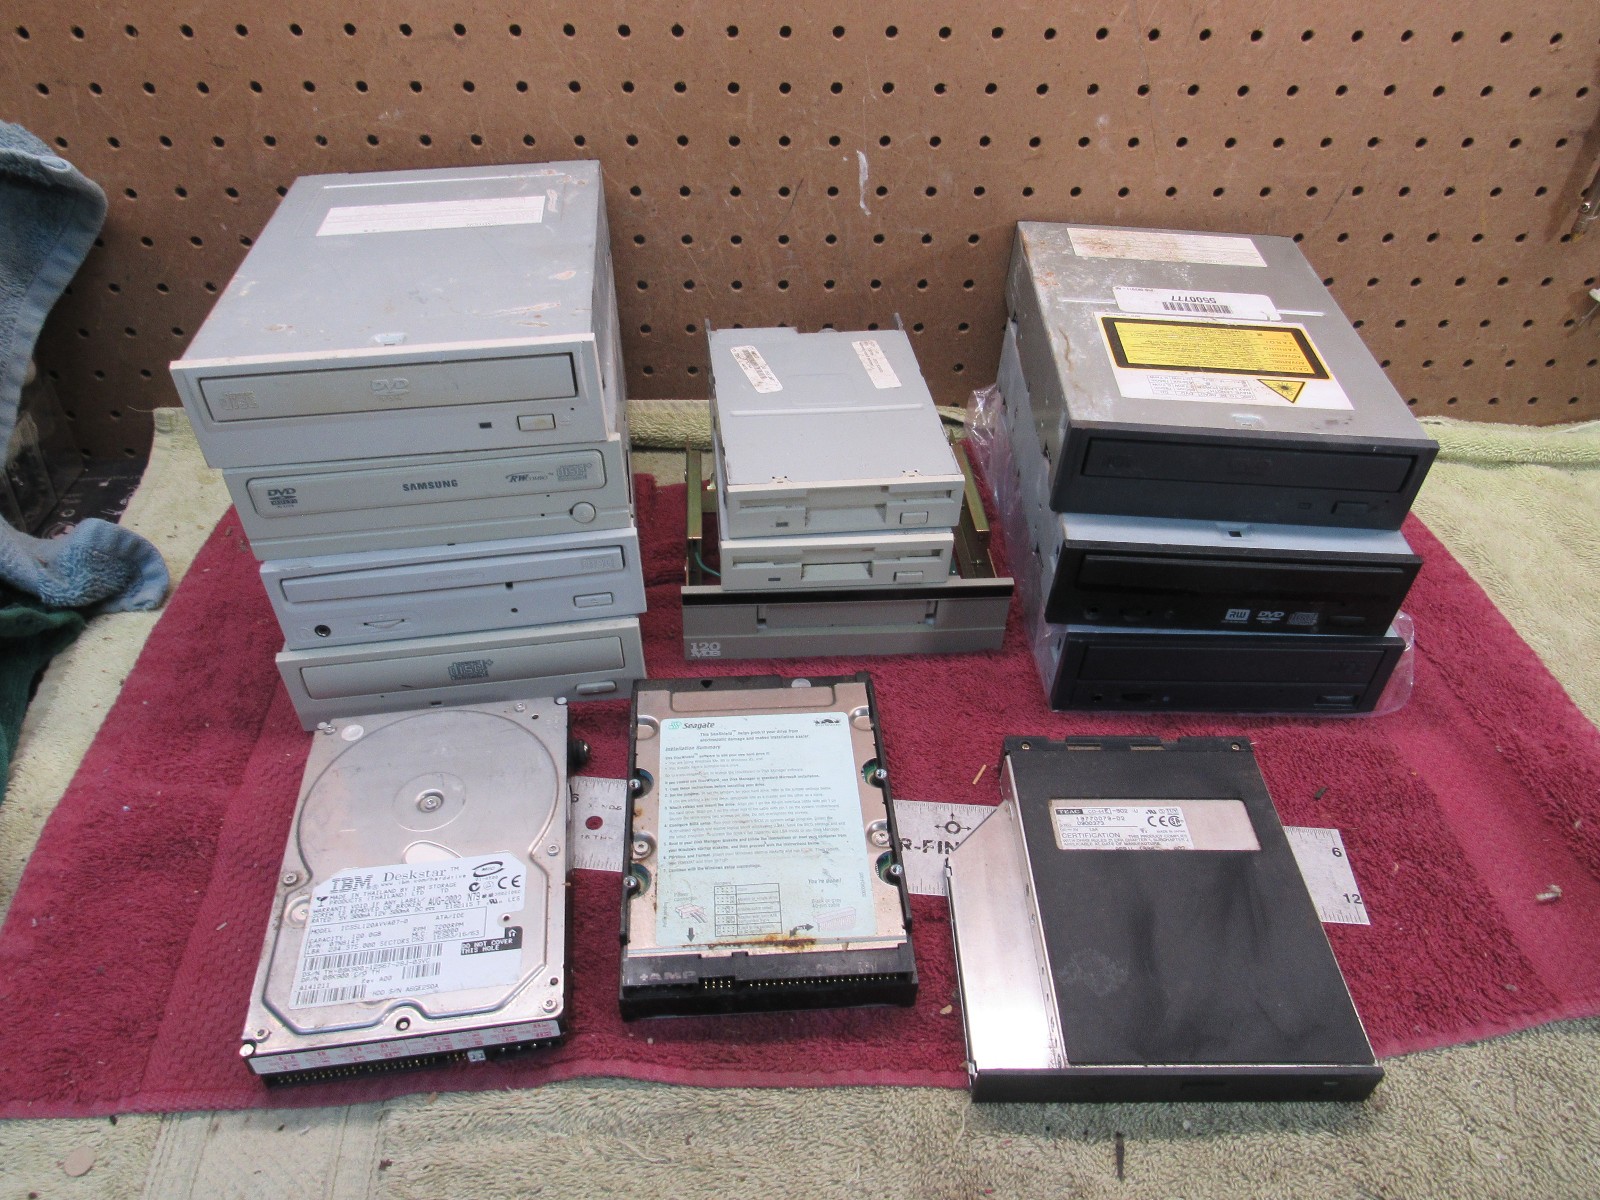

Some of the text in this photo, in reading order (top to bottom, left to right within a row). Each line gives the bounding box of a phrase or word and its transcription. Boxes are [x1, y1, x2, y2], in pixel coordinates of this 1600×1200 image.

[1171, 295, 1216, 304] 5500777
[370, 377, 410, 390] DVD
[403, 479, 458, 492] SAMSUNG
[268, 488, 297, 496] DVD
[690, 642, 721, 651] 120
[683, 721, 715, 730] Seagate
[1147, 815, 1169, 827] CE
[1332, 847, 1343, 858] 6
[330, 874, 373, 894] IBM
[384, 869, 447, 882] Deskstar
[363, 888, 396, 897] THAILAND
[428, 894, 462, 906] AUG-2002
[1343, 893, 1363, 905] 12
[491, 938, 513, 946] COVER
[482, 944, 500, 952] HOLE
